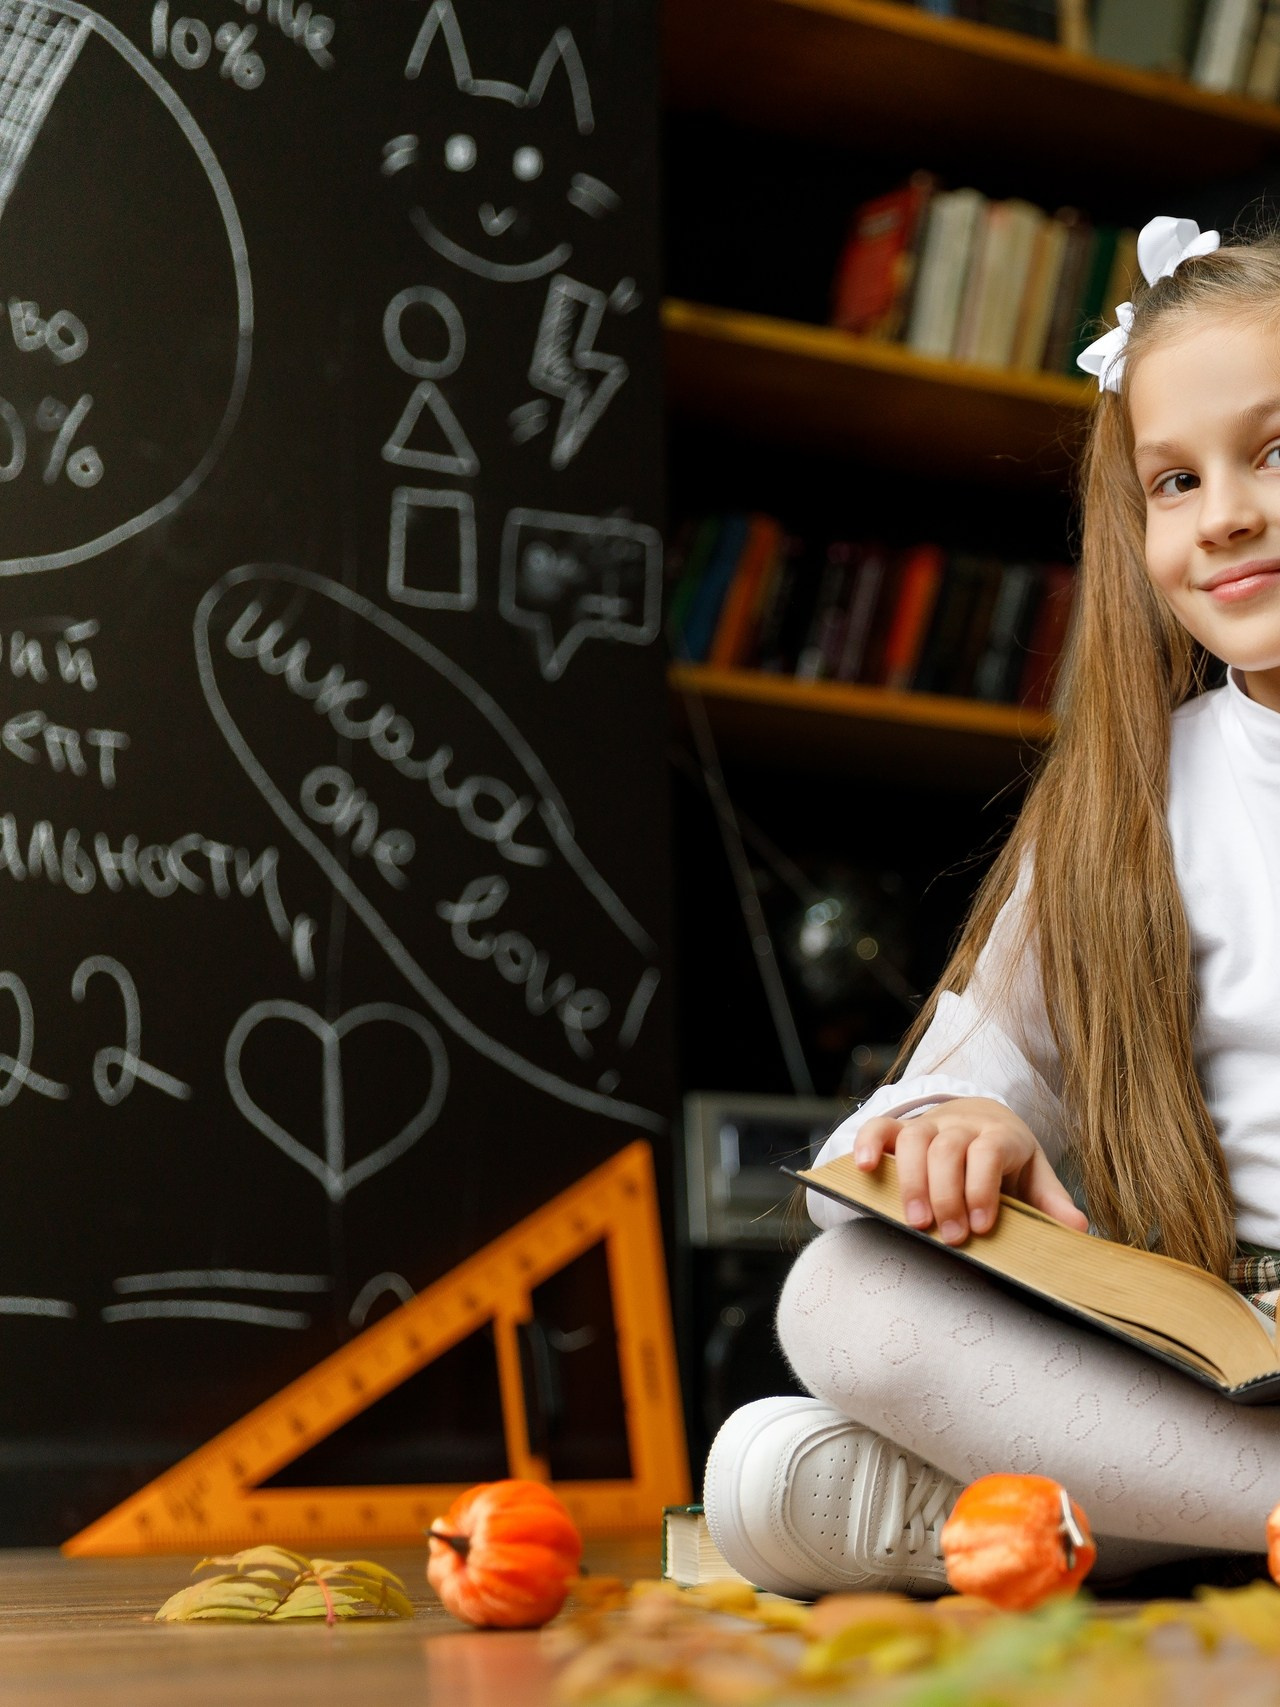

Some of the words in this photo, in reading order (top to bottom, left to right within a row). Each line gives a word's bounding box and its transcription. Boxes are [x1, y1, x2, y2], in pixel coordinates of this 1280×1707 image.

[150, 0, 266, 90] 10%
[0, 298, 89, 364] во
[0, 617, 99, 693] ий
[225, 601, 551, 867] школа
[300, 765, 416, 889] one
[435, 875, 661, 1093] love!
